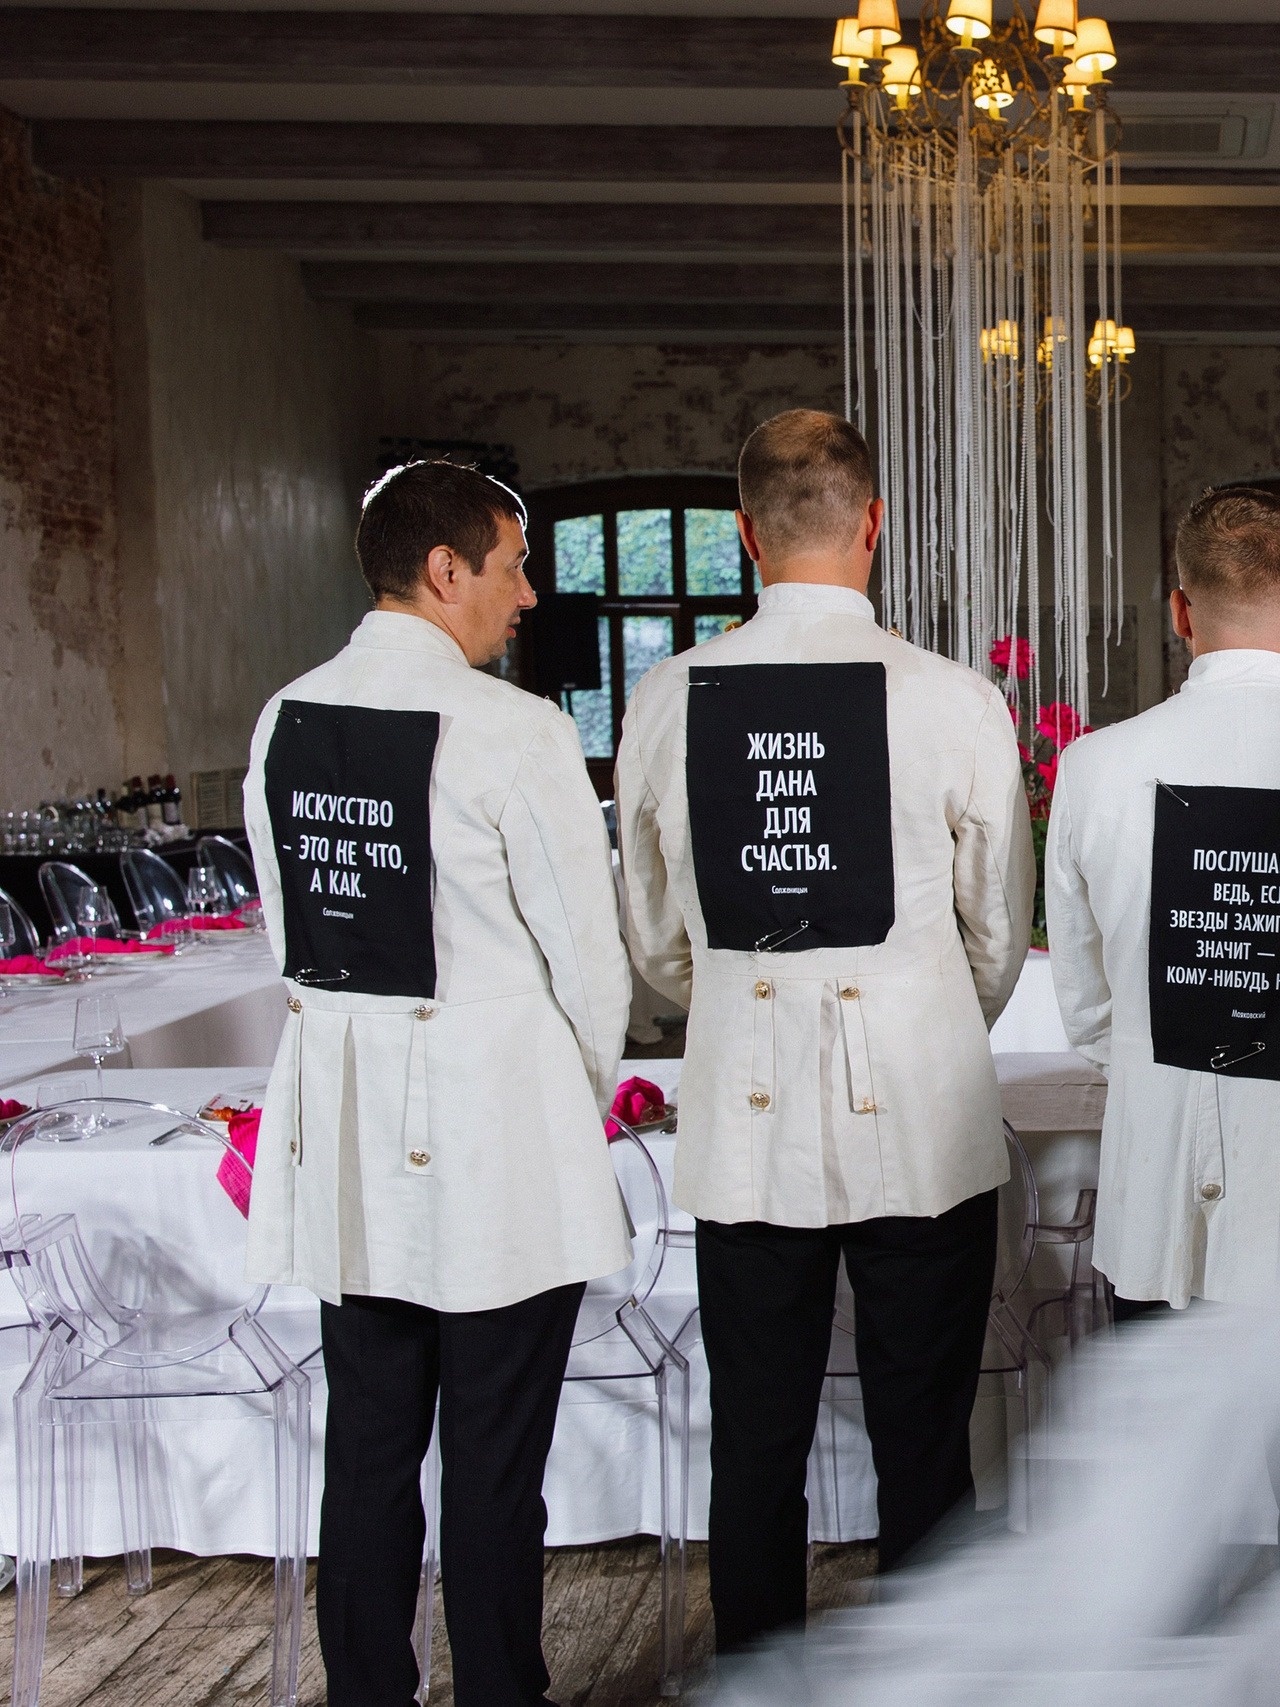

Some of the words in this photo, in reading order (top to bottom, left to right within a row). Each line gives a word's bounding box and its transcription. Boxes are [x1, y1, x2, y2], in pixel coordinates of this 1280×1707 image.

[747, 732, 825, 759] ЖИЗНЬ
[756, 770, 817, 801] ДАНА
[292, 791, 393, 827] ИСКУССТВО
[764, 807, 810, 839] ДЛЯ
[299, 835, 329, 862] ЭТО
[336, 839, 357, 865] НЕ
[365, 842, 407, 874] ЧТО,
[741, 844, 837, 871] СЧАСТЬЯ.
[310, 868, 322, 893] А
[330, 870, 366, 898] КАК.
[1214, 883, 1254, 906] ВЕДЬ,
[1170, 910, 1228, 932] ЗВЕЗДЫ
[1196, 940, 1251, 960] ЗНАЧИТ
[1167, 966, 1269, 993] КОМУ-НИБУДЬ
